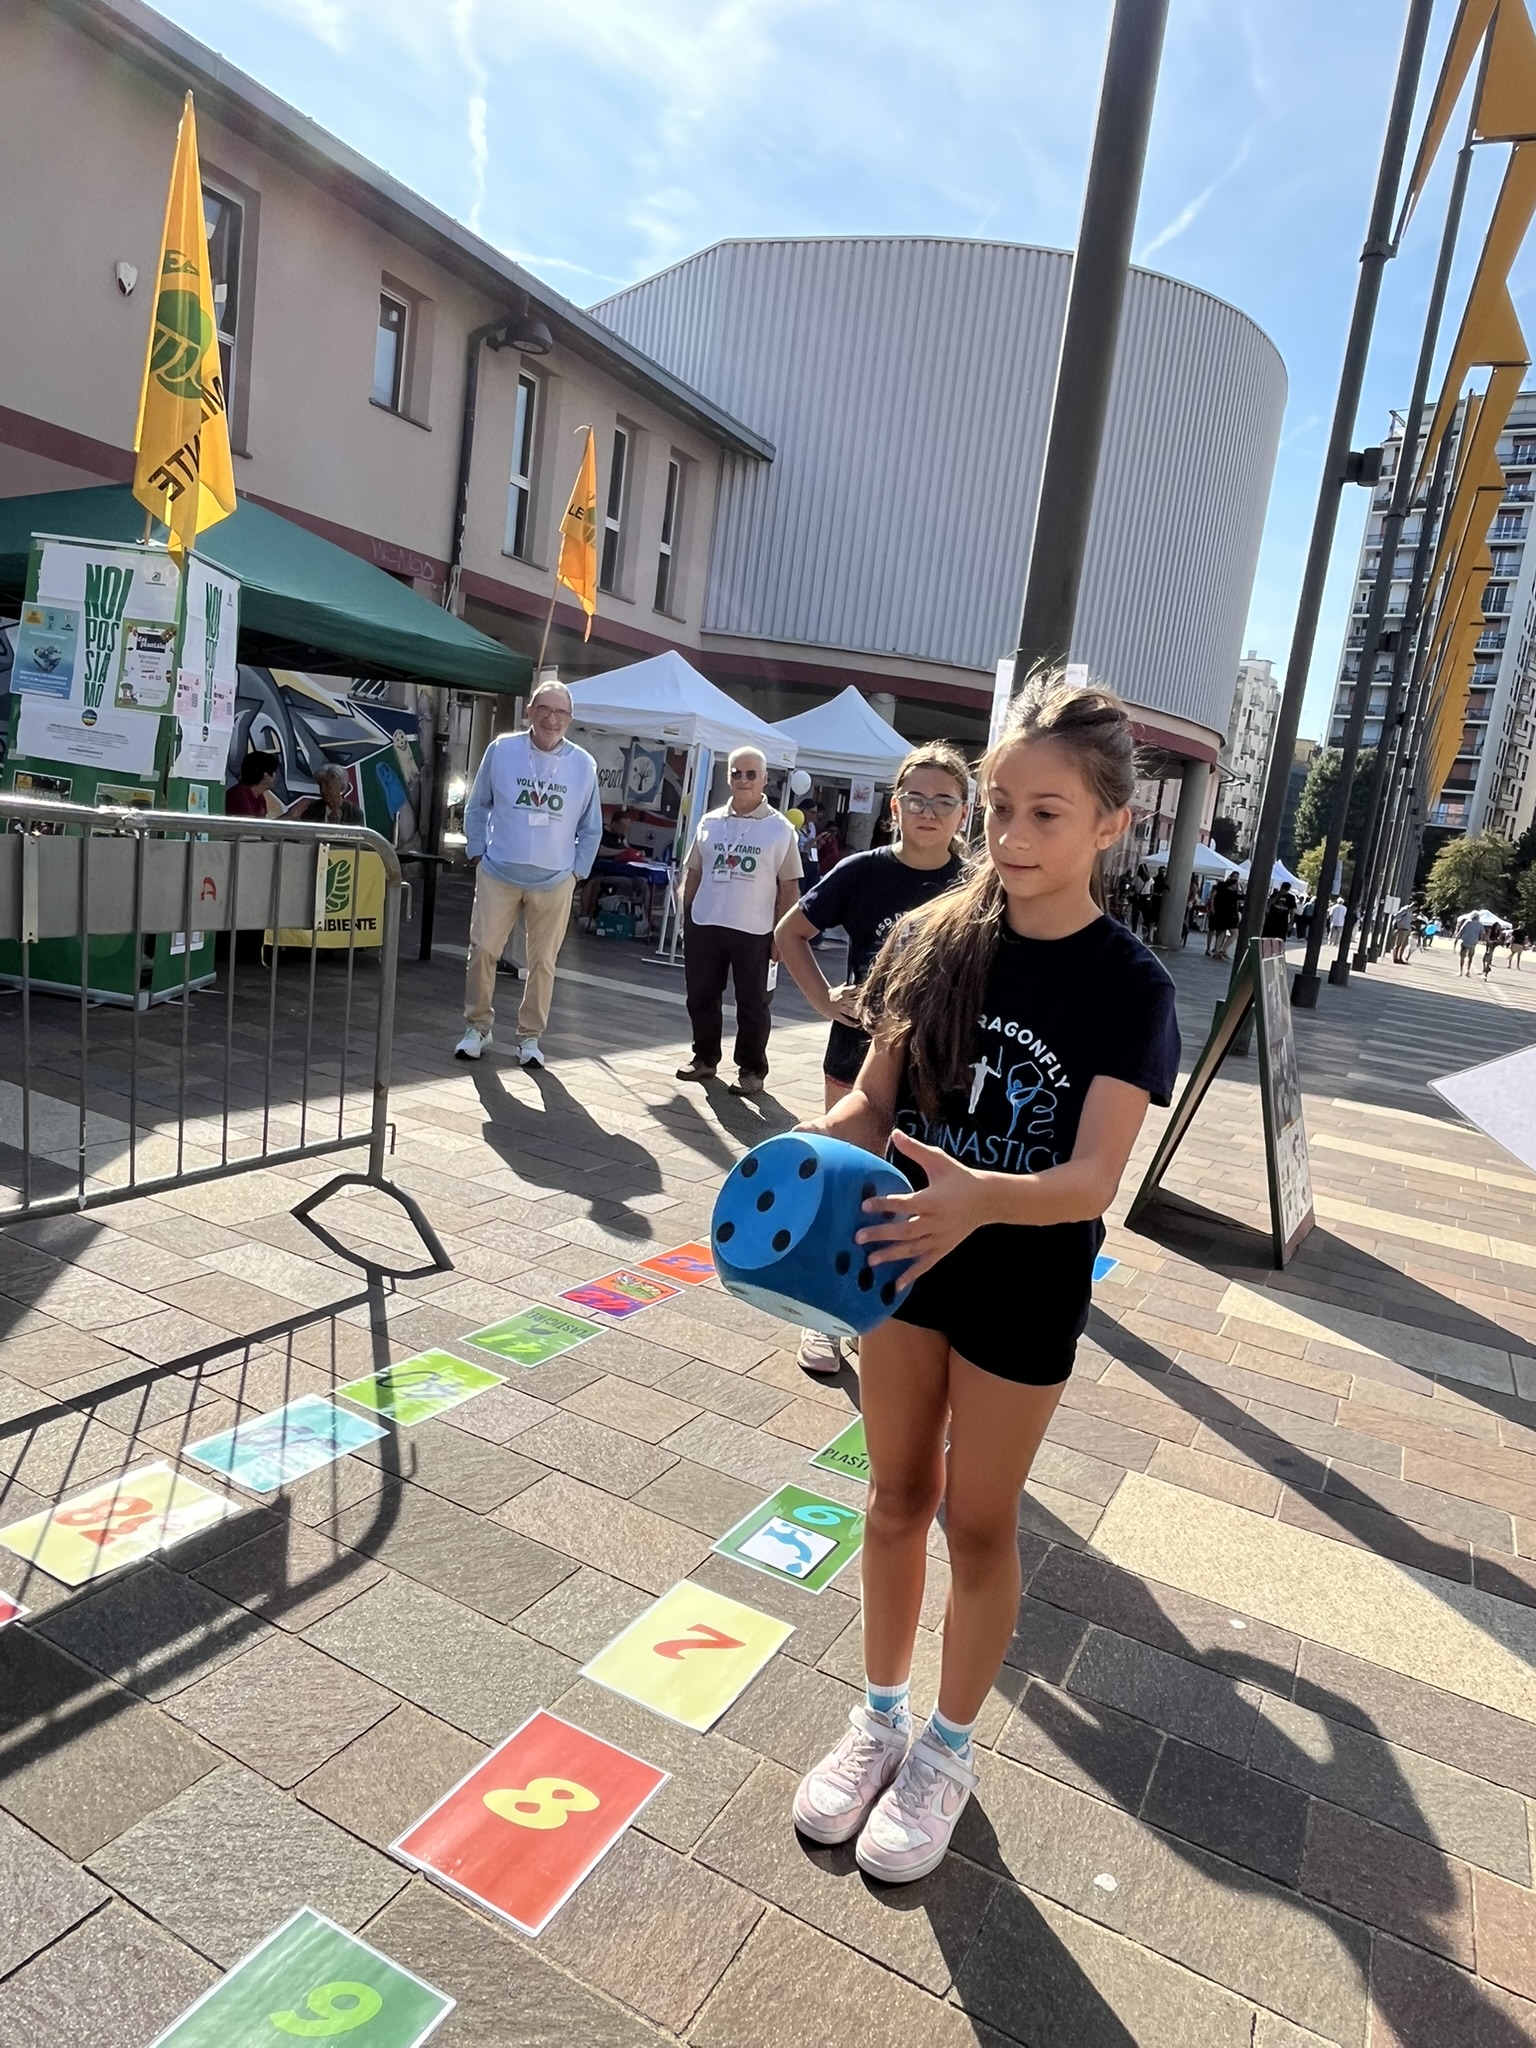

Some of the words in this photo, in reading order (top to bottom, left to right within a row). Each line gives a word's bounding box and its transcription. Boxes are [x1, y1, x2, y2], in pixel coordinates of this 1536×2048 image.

[84, 563, 135, 622] NOI
[85, 618, 120, 652] POS
[977, 1013, 1071, 1088] RAGONFLY
[653, 1623, 746, 1660] 7
[483, 1777, 600, 1830] 8
